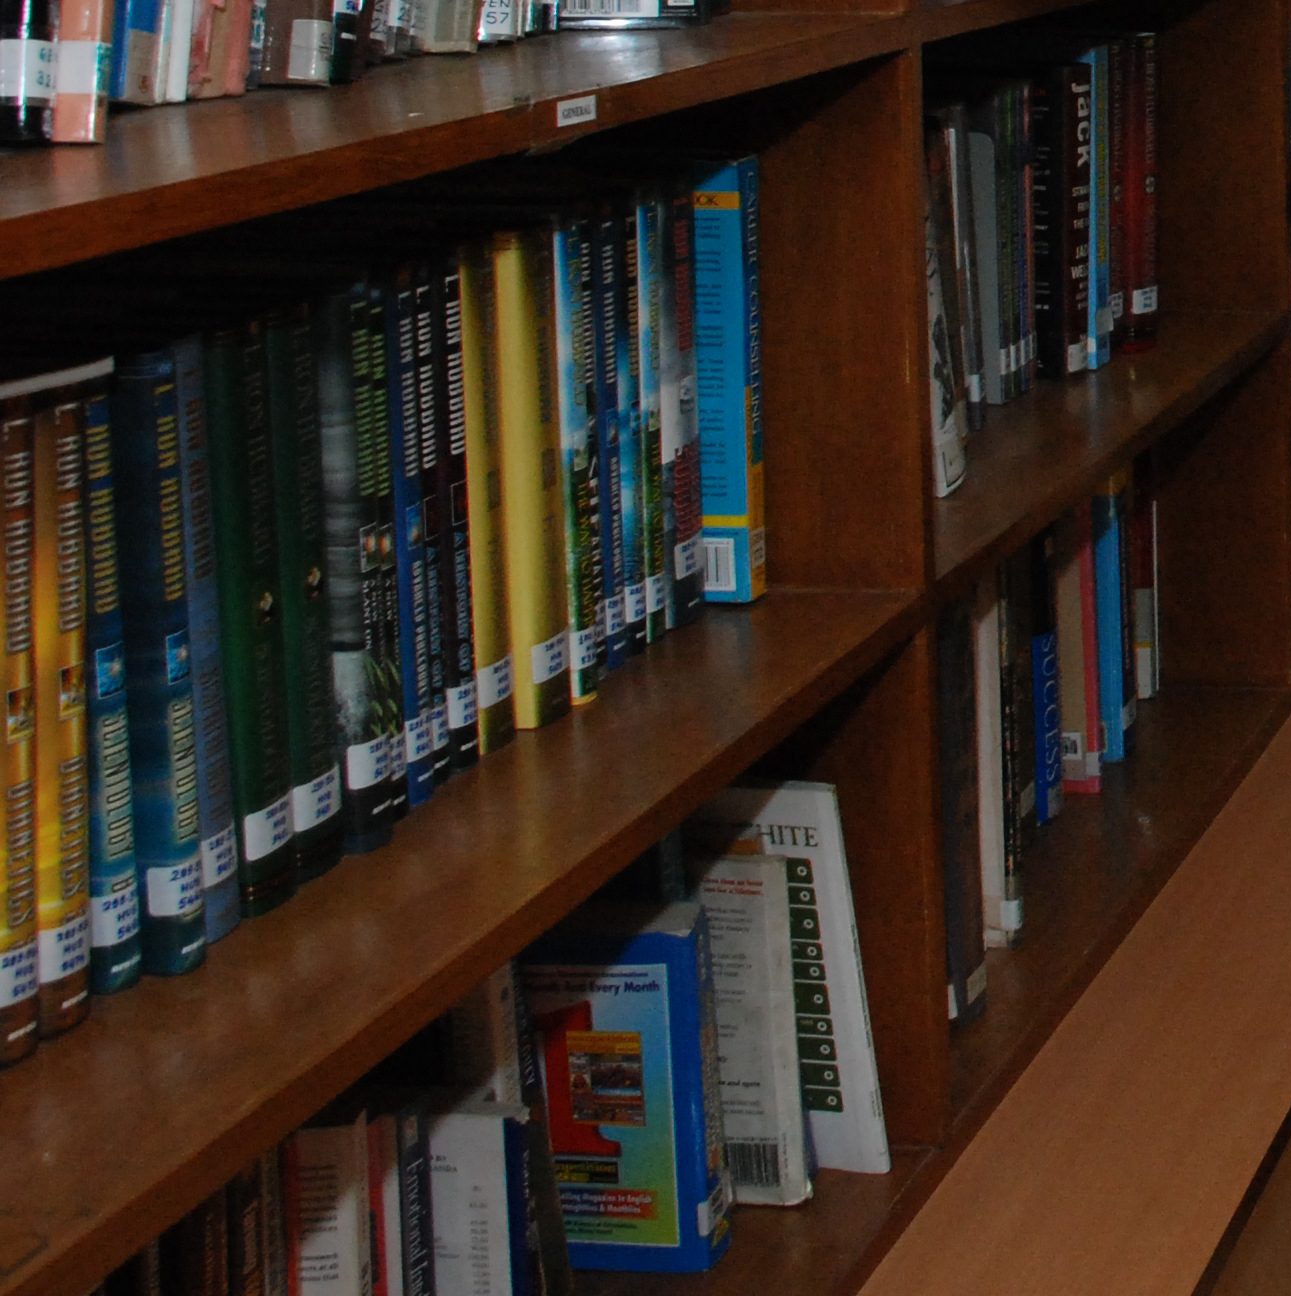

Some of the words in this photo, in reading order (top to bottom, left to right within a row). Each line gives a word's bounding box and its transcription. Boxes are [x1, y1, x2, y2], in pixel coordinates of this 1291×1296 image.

[486, 11, 510, 25] 57
[562, 106, 593, 120] GENERAL
[745, 171, 762, 265] CAREER
[445, 300, 461, 345] RON
[748, 274, 769, 436] COUNSELLING
[56, 435, 83, 491] RON
[157, 416, 180, 470] RON
[447, 353, 465, 456] HUBBARD
[57, 501, 84, 634] HUBBARD
[159, 477, 186, 603] HUBBARD
[1042, 637, 1061, 783] SUCCESS
[59, 754, 88, 901] DIANETICS
[103, 713, 135, 861] SCIENTOLOGY
[172, 703, 199, 844] SCIENTOLOGY
[7, 779, 35, 929] DIANETICS
